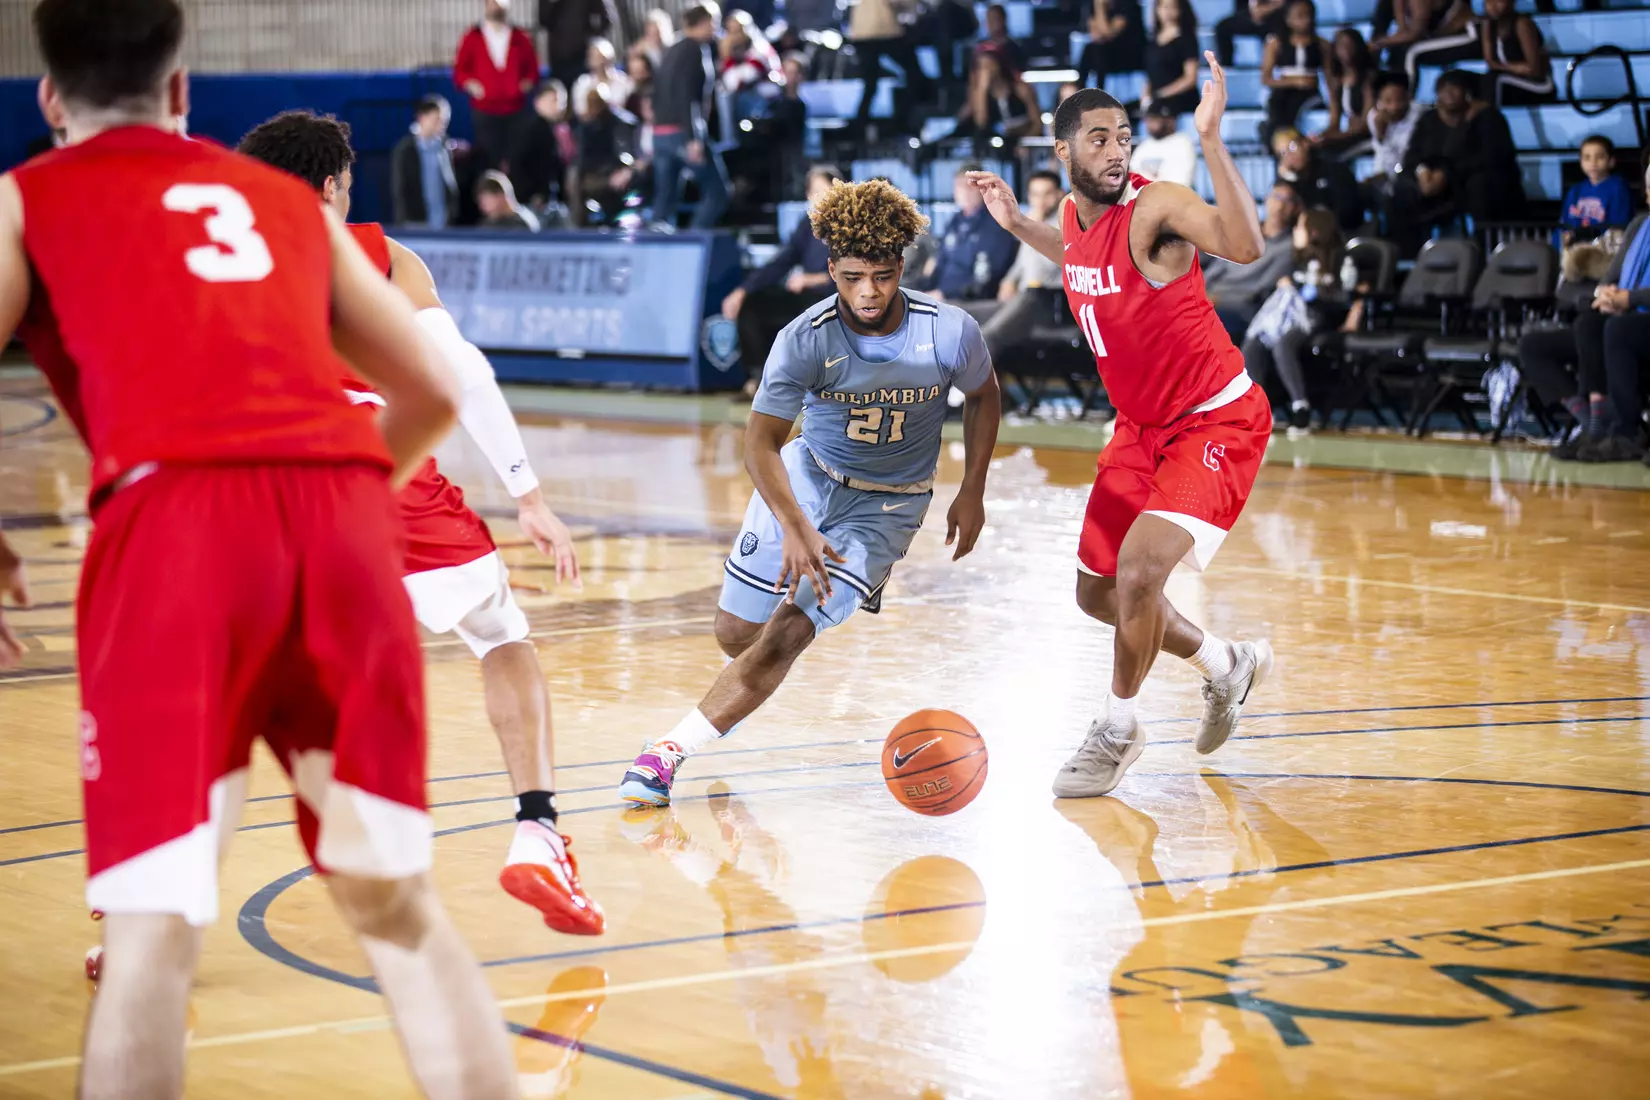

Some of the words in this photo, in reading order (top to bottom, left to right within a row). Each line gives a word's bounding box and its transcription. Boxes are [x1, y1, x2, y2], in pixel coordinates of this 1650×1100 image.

[161, 183, 275, 283] 3
[488, 252, 632, 297] MARKETING
[1065, 263, 1122, 297] CORNELL
[521, 304, 623, 347] SPORTS
[1078, 303, 1108, 358] 11
[820, 383, 941, 406] COLUMBIA
[845, 406, 908, 446] 21
[903, 775, 953, 799] ELITE
[1110, 919, 1602, 997] LEAGU
